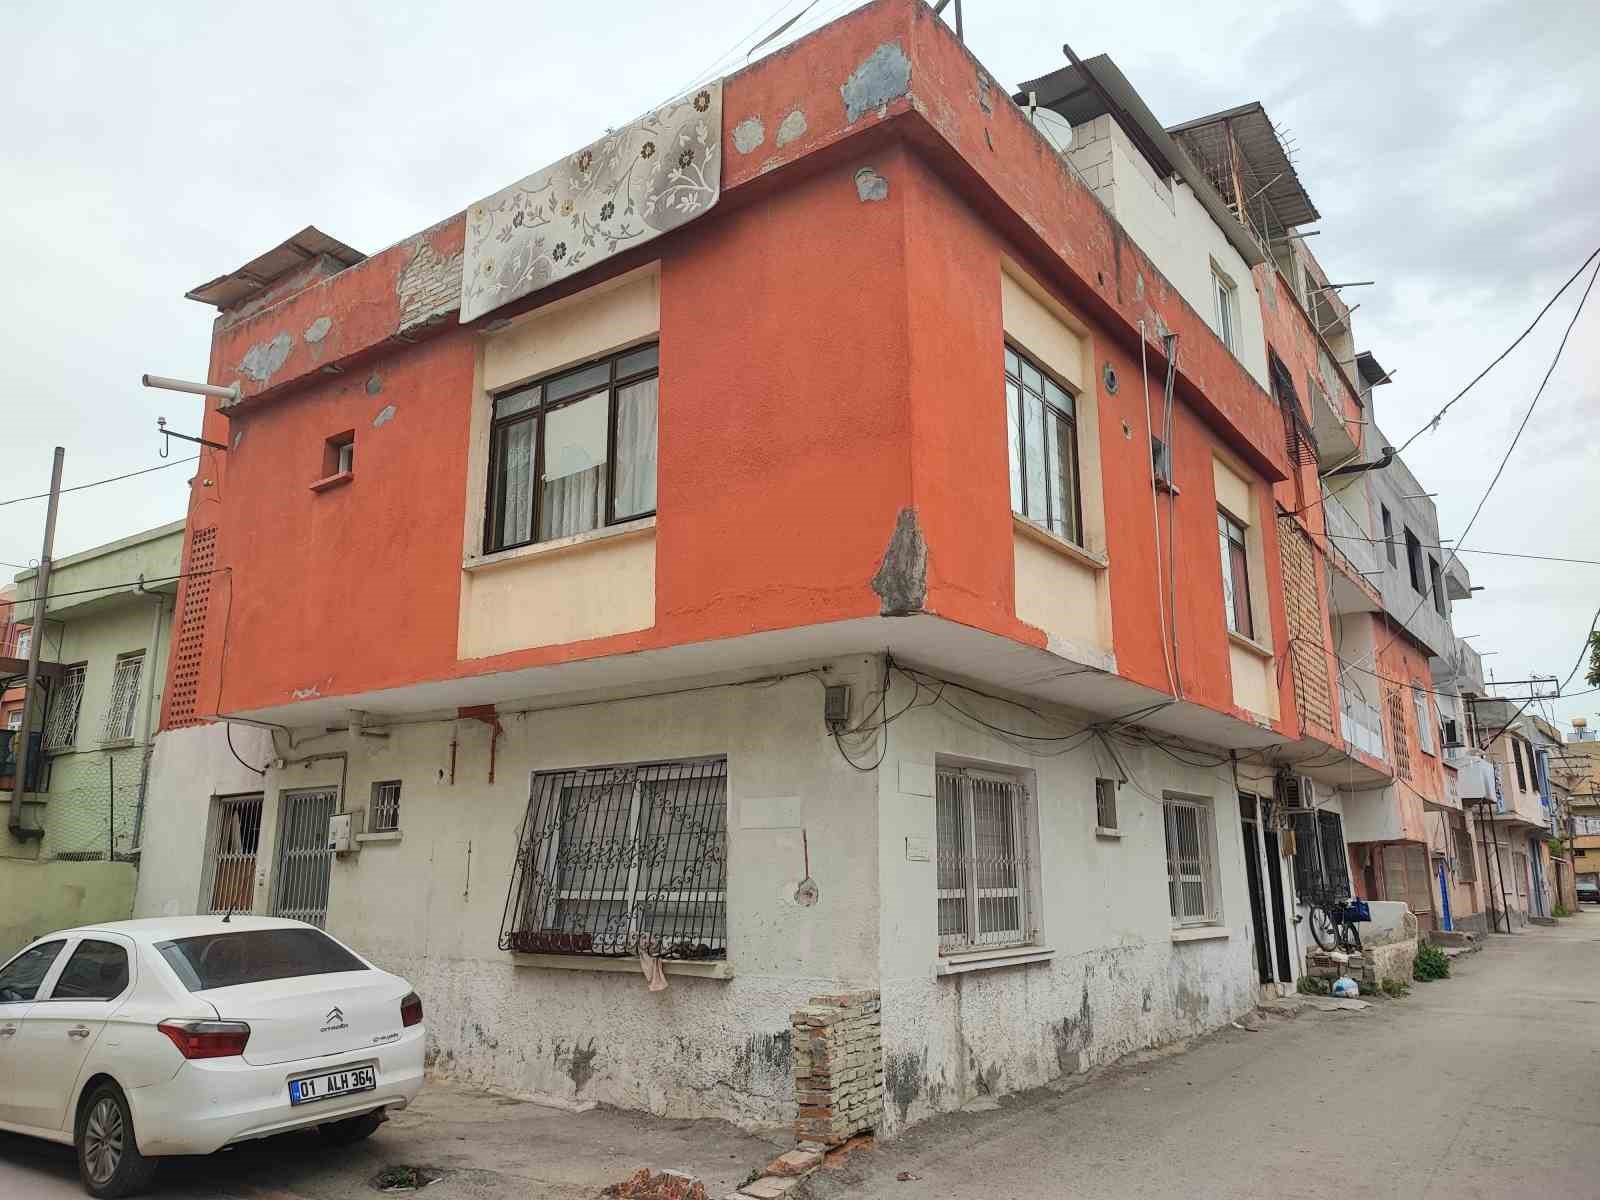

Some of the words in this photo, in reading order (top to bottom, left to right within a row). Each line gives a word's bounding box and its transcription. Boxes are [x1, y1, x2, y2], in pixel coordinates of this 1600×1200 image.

[301, 1080, 316, 1097] 01
[327, 1073, 349, 1092] ALH
[351, 1070, 372, 1087] 364
